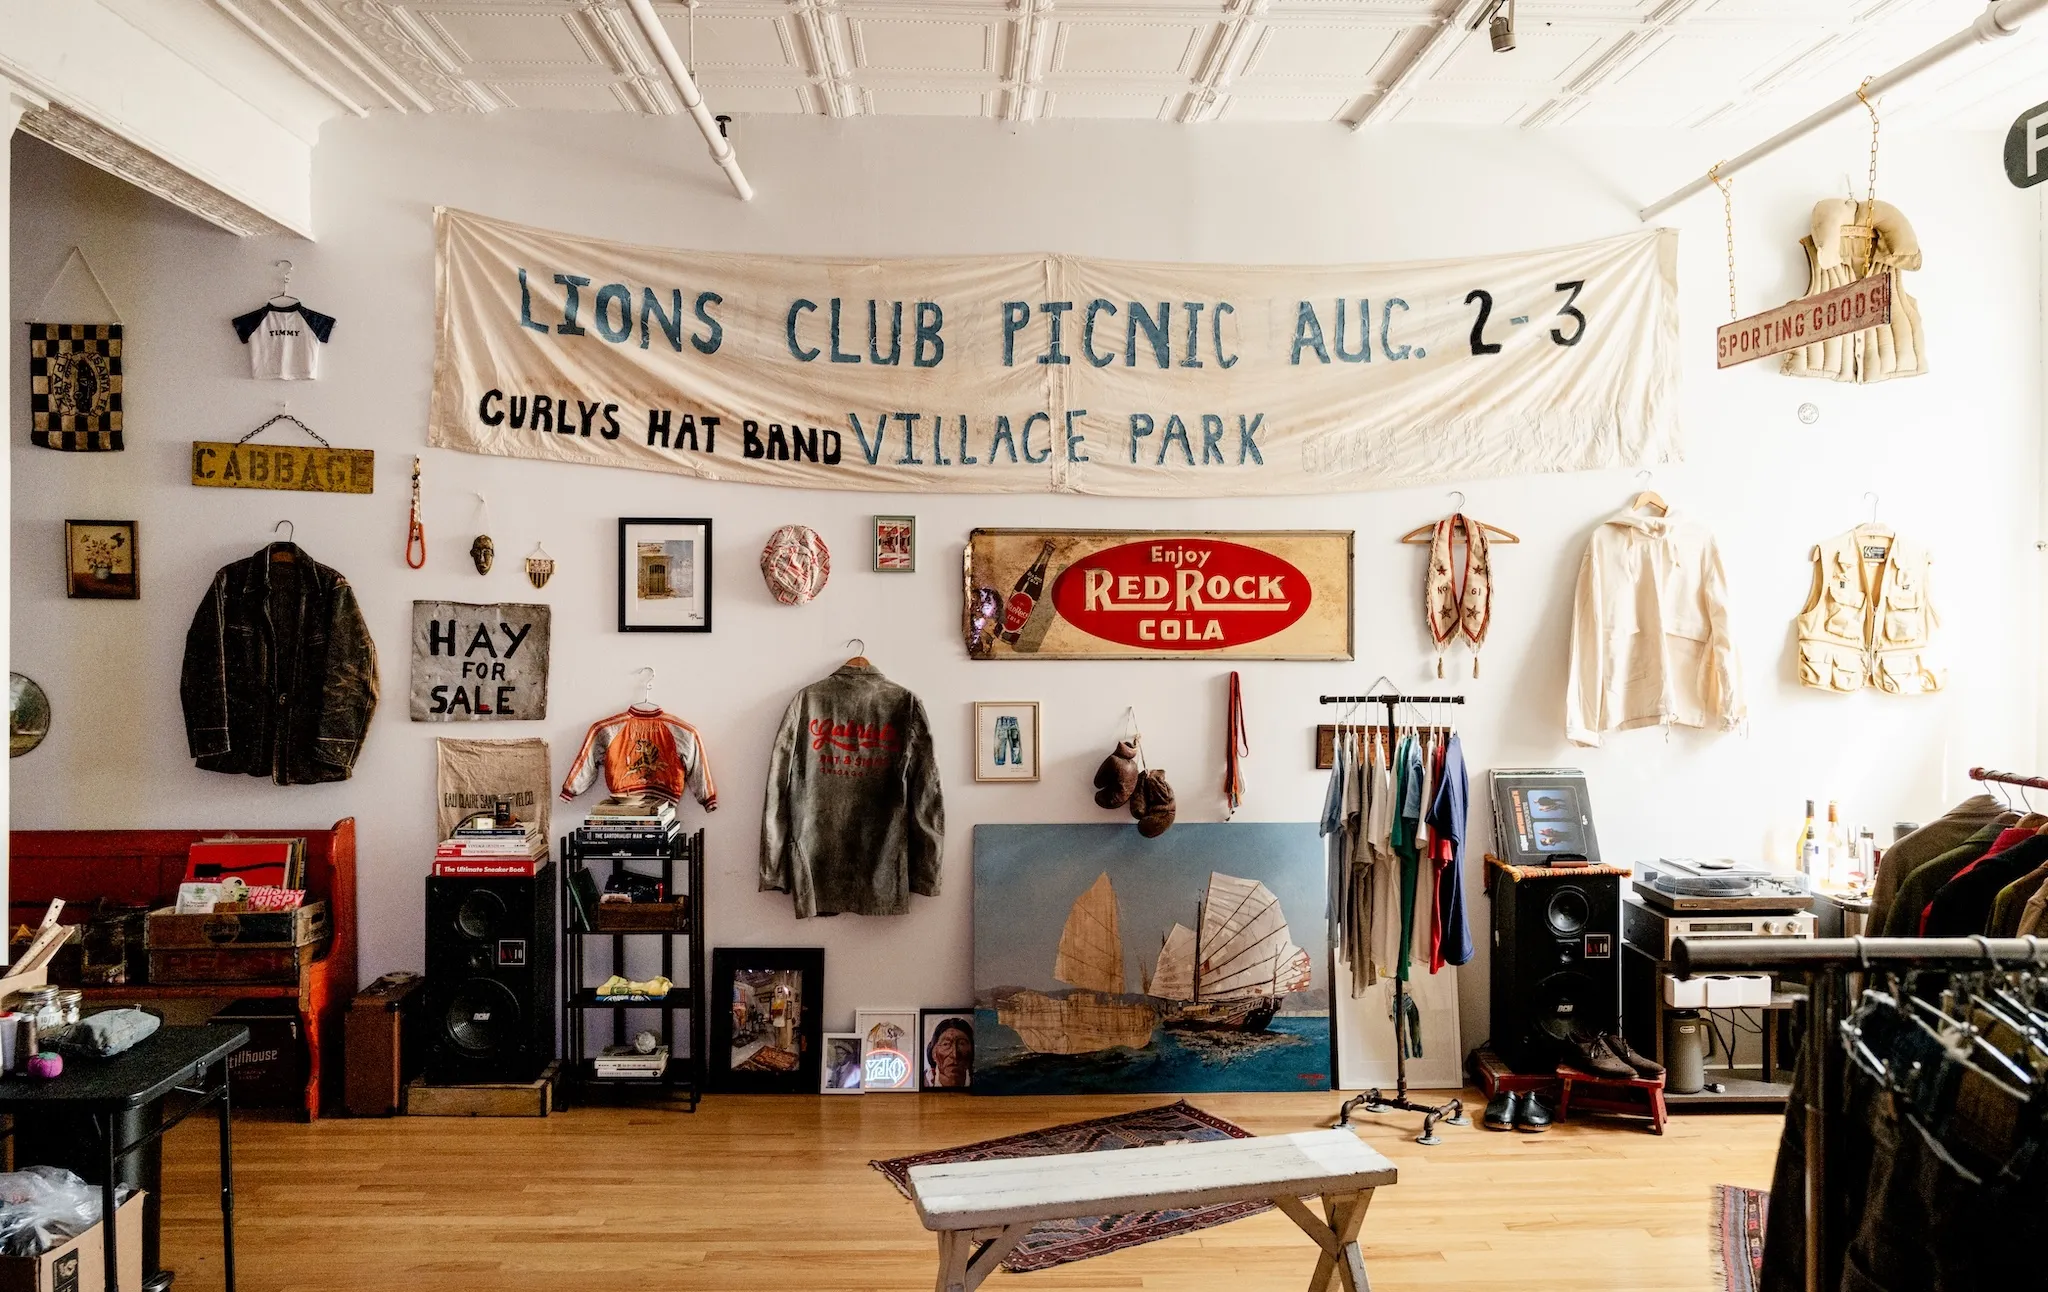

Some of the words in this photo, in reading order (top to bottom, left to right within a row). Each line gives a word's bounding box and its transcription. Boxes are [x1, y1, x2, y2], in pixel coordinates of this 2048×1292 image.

[518, 266, 723, 355] LIONS
[787, 297, 944, 367] CLUB
[1002, 298, 1240, 369] PICNIC
[1290, 298, 1426, 365] AUG.
[1718, 313, 1805, 358] SPORTING
[1813, 287, 1882, 331] GOODS
[53, 363, 66, 407] PARK
[93, 356, 109, 393] SANTA
[96, 398, 107, 411] FE
[478, 388, 621, 440] CURLYS
[647, 408, 721, 453] HAT
[742, 419, 842, 466] BAND
[849, 409, 1089, 466] VILLAGE
[1129, 412, 1265, 467] PARK
[195, 448, 374, 486] CABBAGE
[1151, 545, 1212, 569] Enjoy
[430, 619, 532, 658] HAY
[1138, 619, 1224, 641] COLA
[462, 662, 506, 681] FOR
[430, 685, 516, 715] SALE
[228, 1050, 278, 1069] tillhouse
